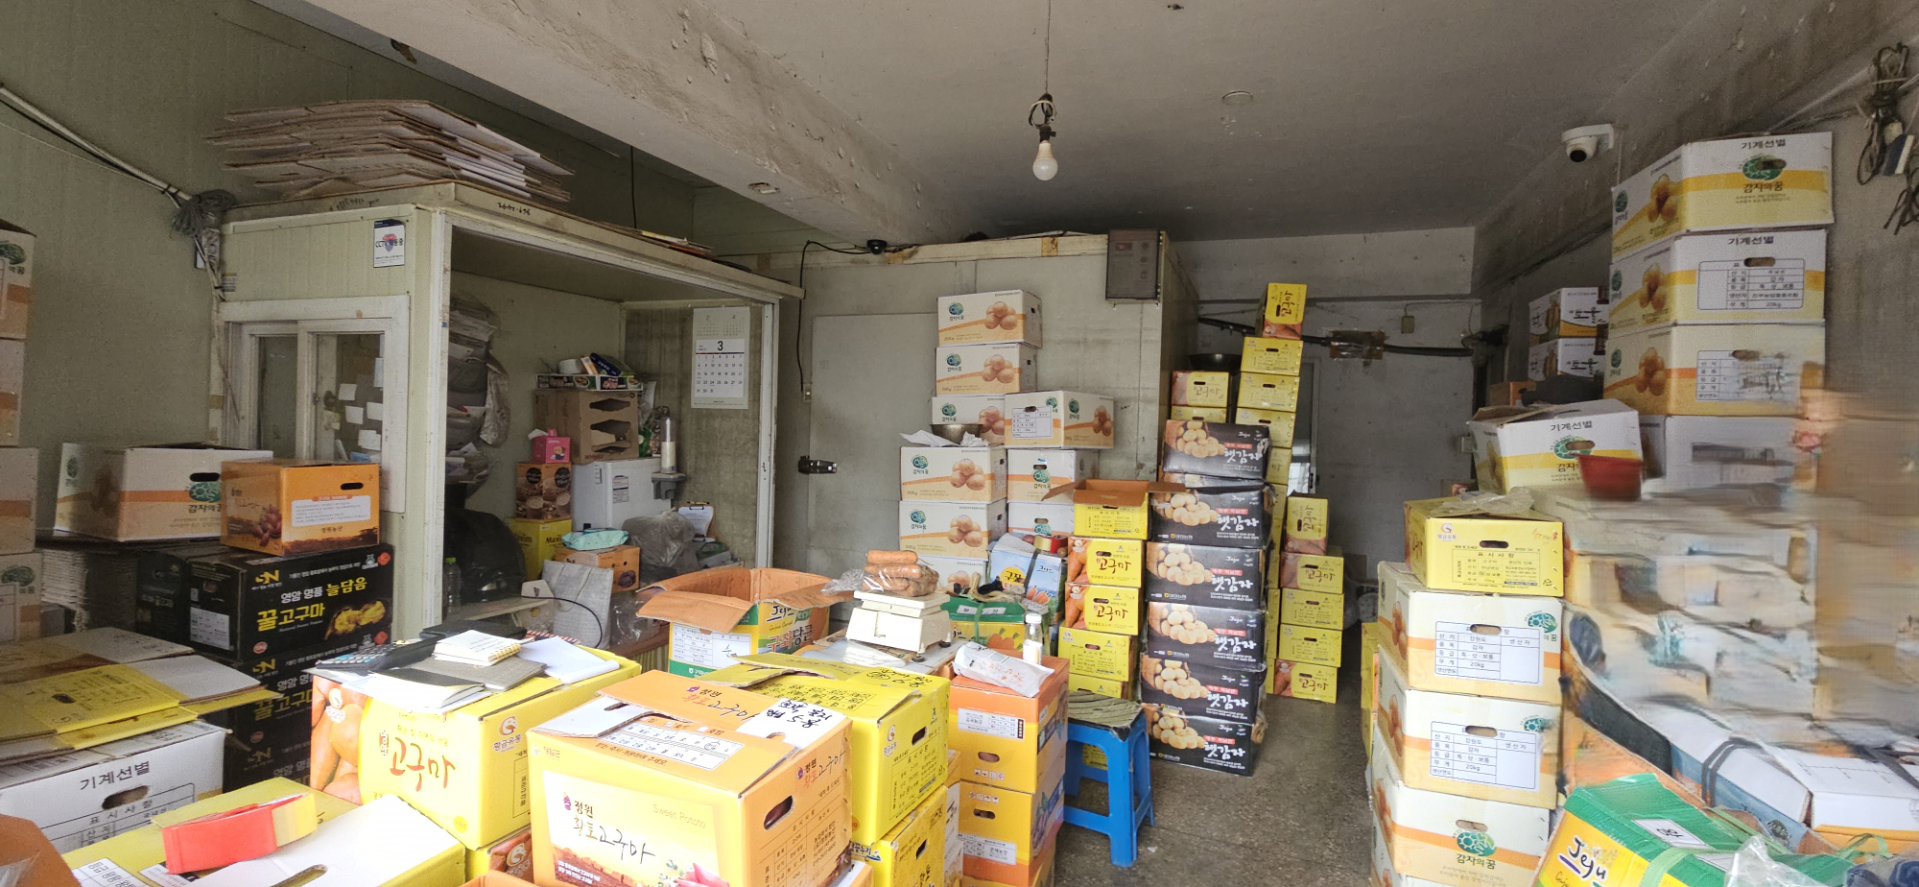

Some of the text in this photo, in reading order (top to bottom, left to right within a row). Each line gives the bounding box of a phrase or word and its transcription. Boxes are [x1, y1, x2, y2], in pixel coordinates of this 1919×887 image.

[1741, 138, 1786, 150] 기계선별
[1728, 236, 1774, 245] 기계선별
[717, 340, 724, 351] 3
[1550, 420, 1592, 431] 기계선별
[1099, 558, 1132, 574] 고구마
[281, 576, 368, 604] 영암 명품 늘담음
[1211, 574, 1254, 593] 햇감자
[257, 602, 326, 632] 꿀고구마
[1096, 604, 1129, 622] 고구마
[766, 624, 813, 652] 구좌당근
[1214, 634, 1257, 653] 햇감자
[1207, 691, 1249, 710] 햇감자
[493, 733, 522, 751] 황금유통
[1204, 741, 1246, 760] 햇감자
[389, 737, 456, 792] 고구마
[80, 761, 150, 790] 기계선별
[573, 800, 594, 819] 정원
[652, 803, 706, 829] Sweet Potato
[1456, 853, 1496, 869] 감자의꿈
[1568, 836, 1607, 879] Jeju
